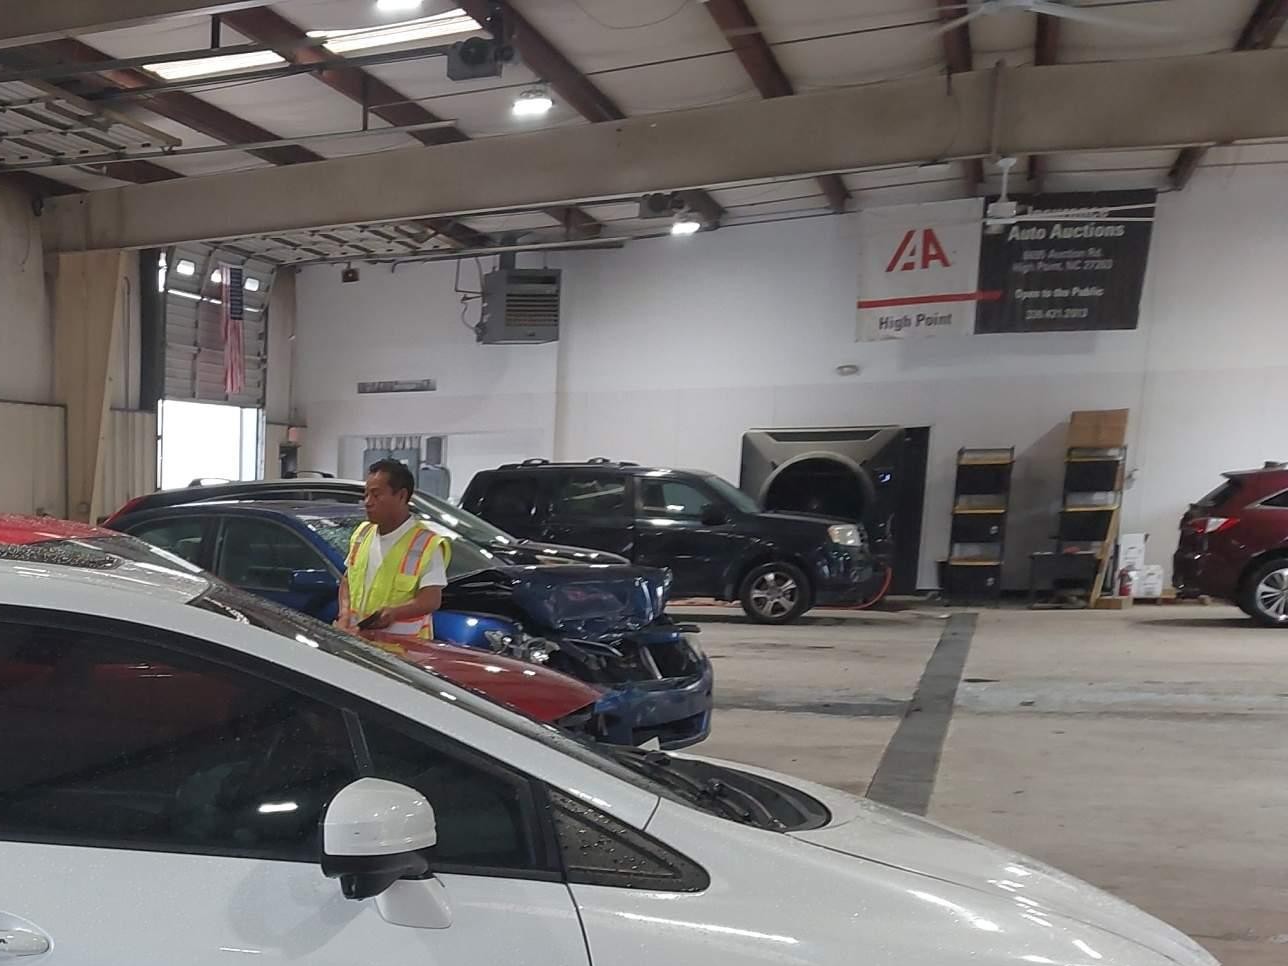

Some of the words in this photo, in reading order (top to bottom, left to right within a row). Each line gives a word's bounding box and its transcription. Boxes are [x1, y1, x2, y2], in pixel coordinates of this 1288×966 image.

[1008, 225, 1047, 242] Auto
[1050, 222, 1125, 239] Auctions
[1071, 286, 1105, 297] Public
[879, 315, 911, 331] High
[915, 312, 952, 328] Point
